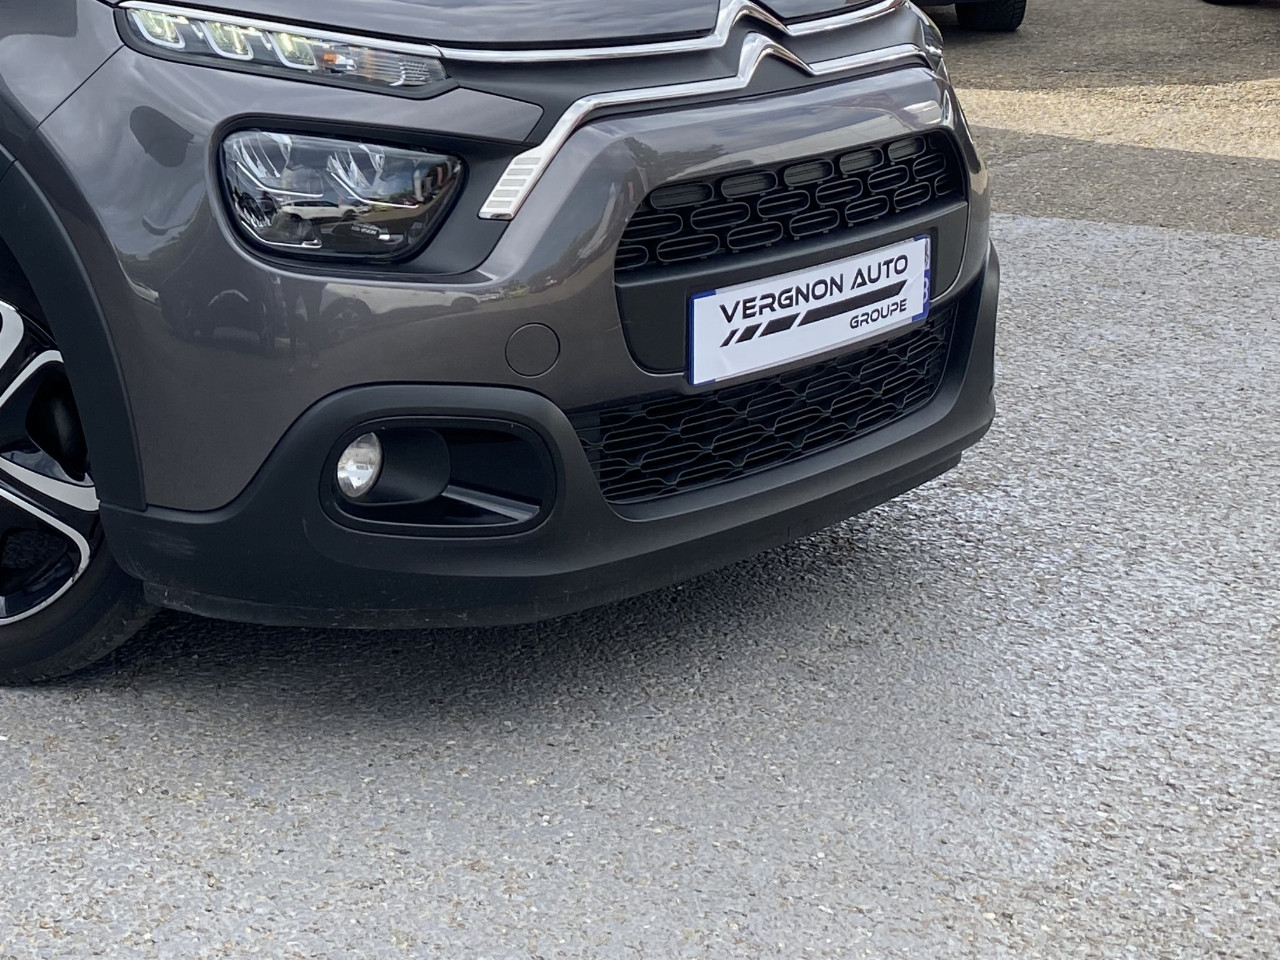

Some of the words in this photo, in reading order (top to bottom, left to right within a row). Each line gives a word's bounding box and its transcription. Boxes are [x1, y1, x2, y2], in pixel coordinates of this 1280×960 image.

[719, 273, 845, 324] VERGNON
[851, 253, 909, 290] AUTO
[849, 298, 908, 330] GROUPE
